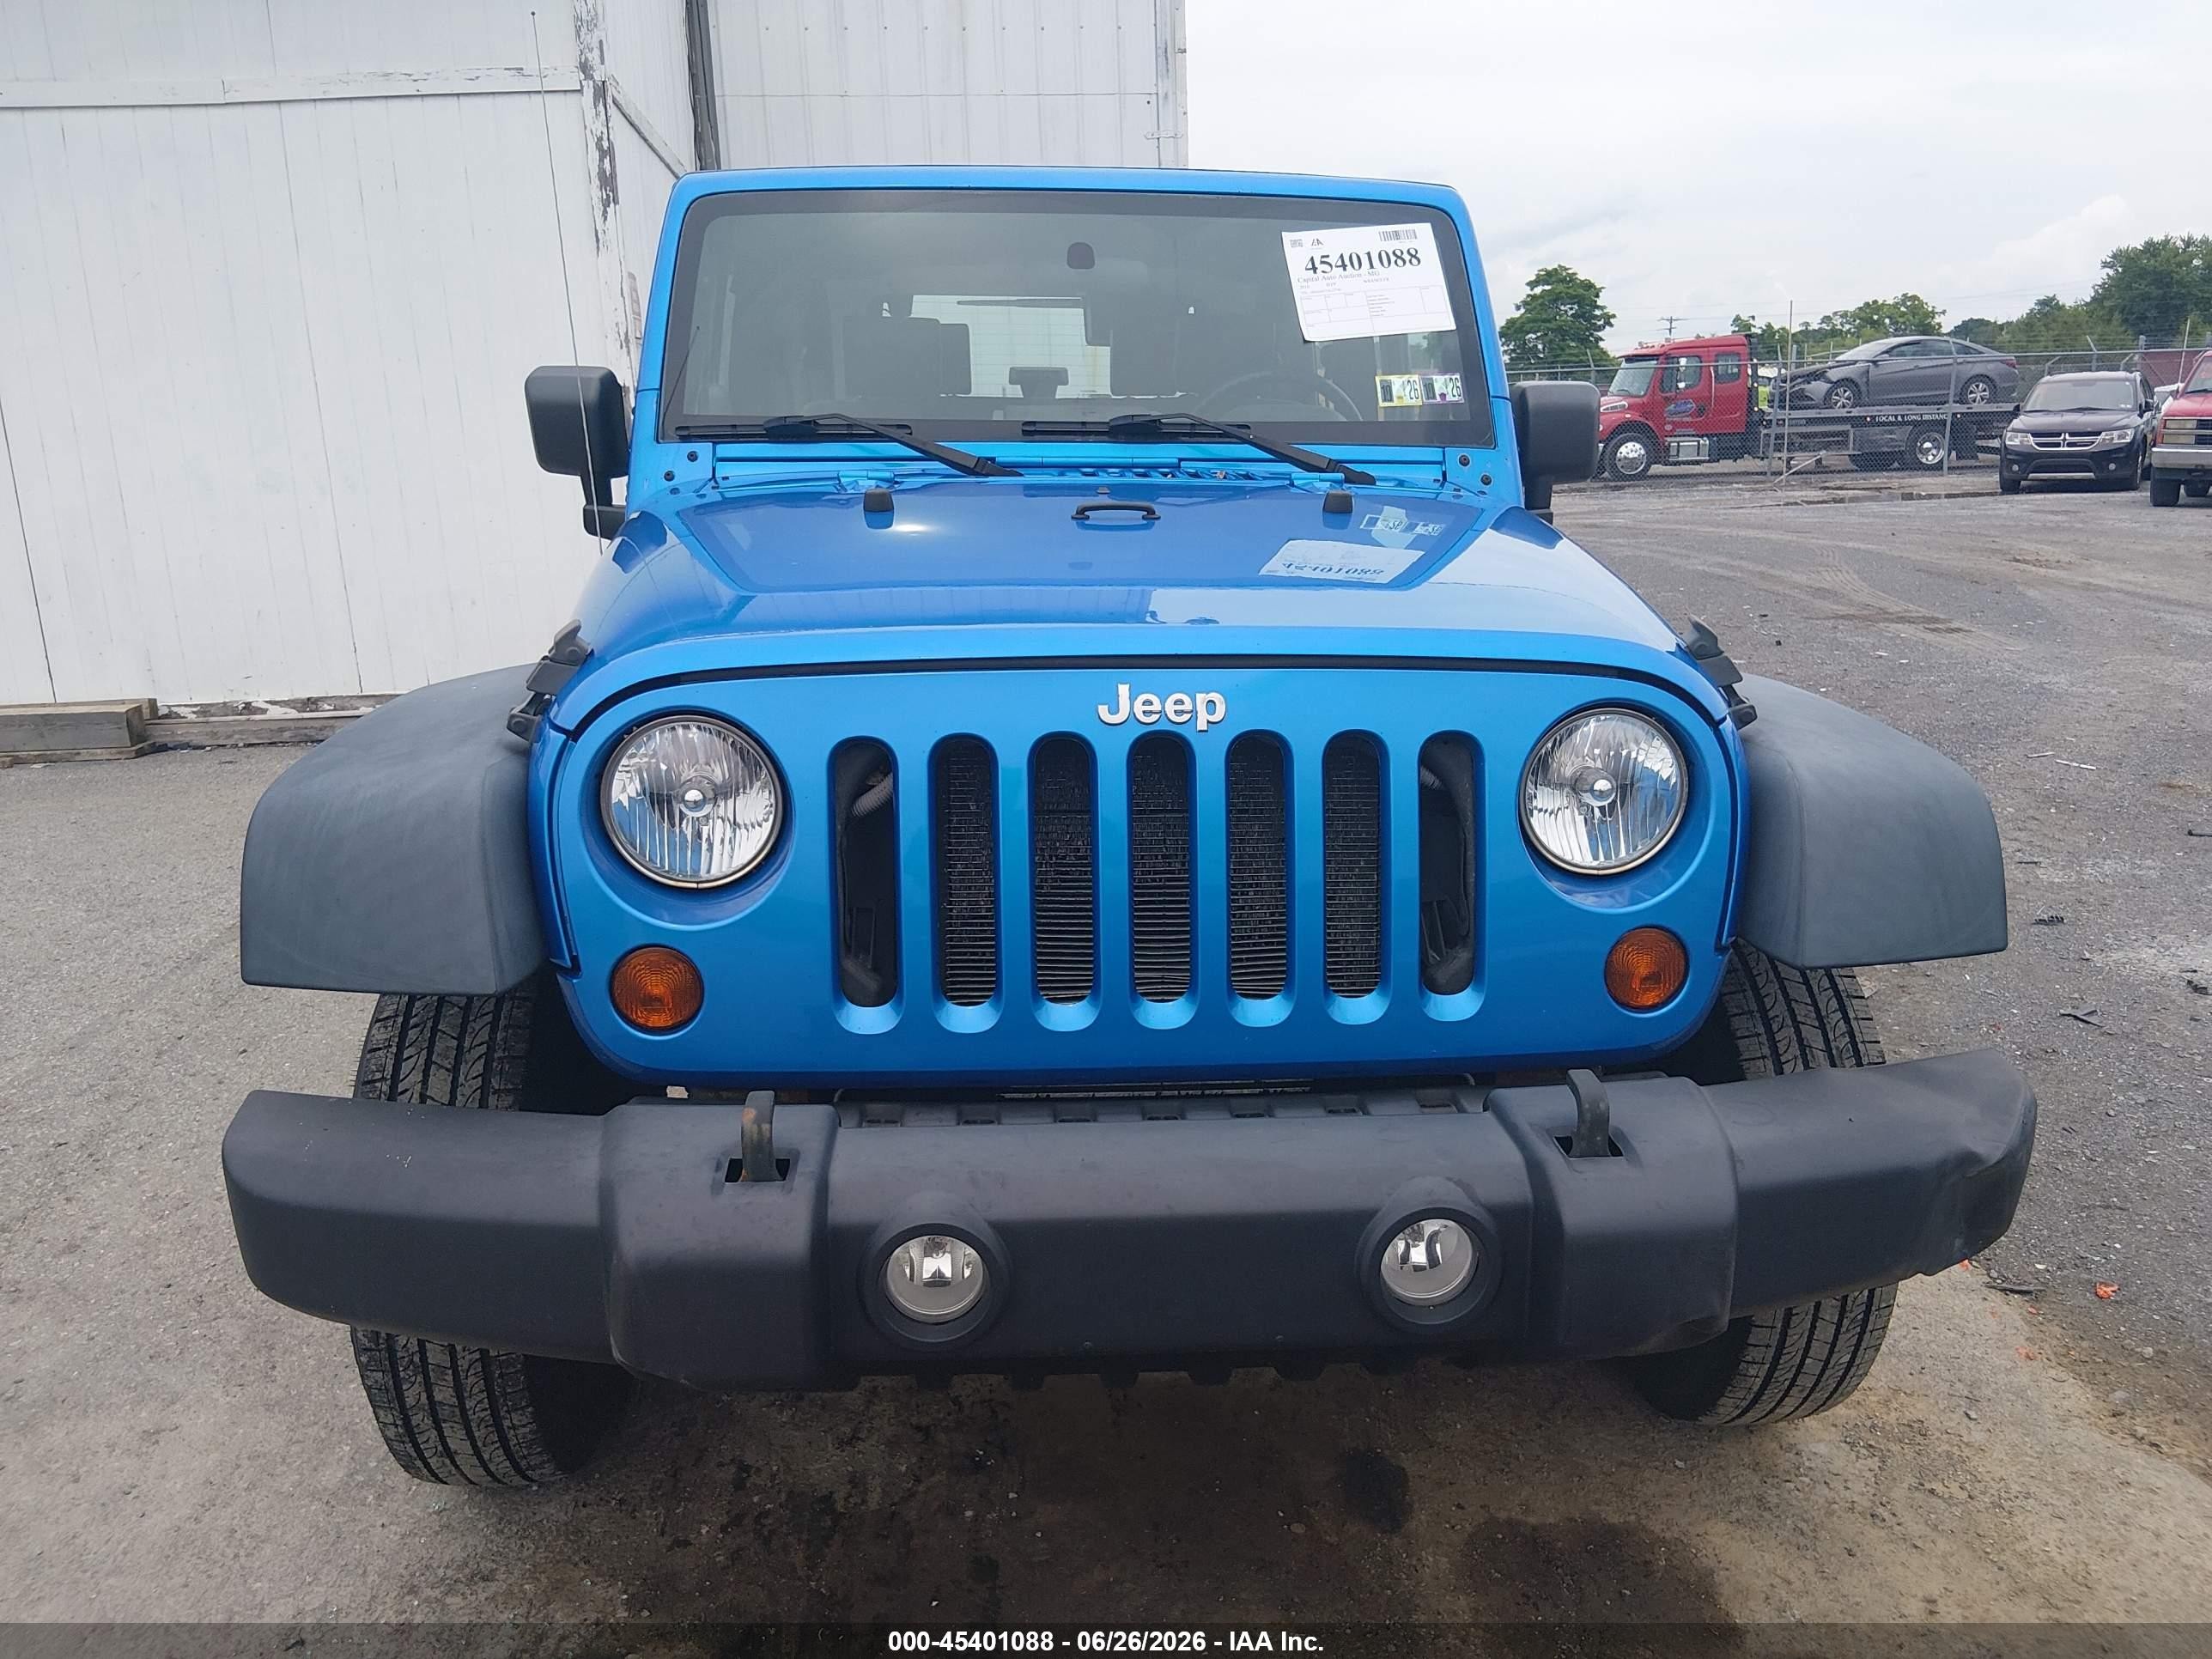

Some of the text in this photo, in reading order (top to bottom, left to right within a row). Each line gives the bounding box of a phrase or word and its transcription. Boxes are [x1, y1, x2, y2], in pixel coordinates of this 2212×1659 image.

[1305, 247, 1421, 274] 45401088
[1407, 380, 1419, 400] 26
[1449, 377, 1462, 398] 26
[1097, 683, 1226, 732] Jeep
